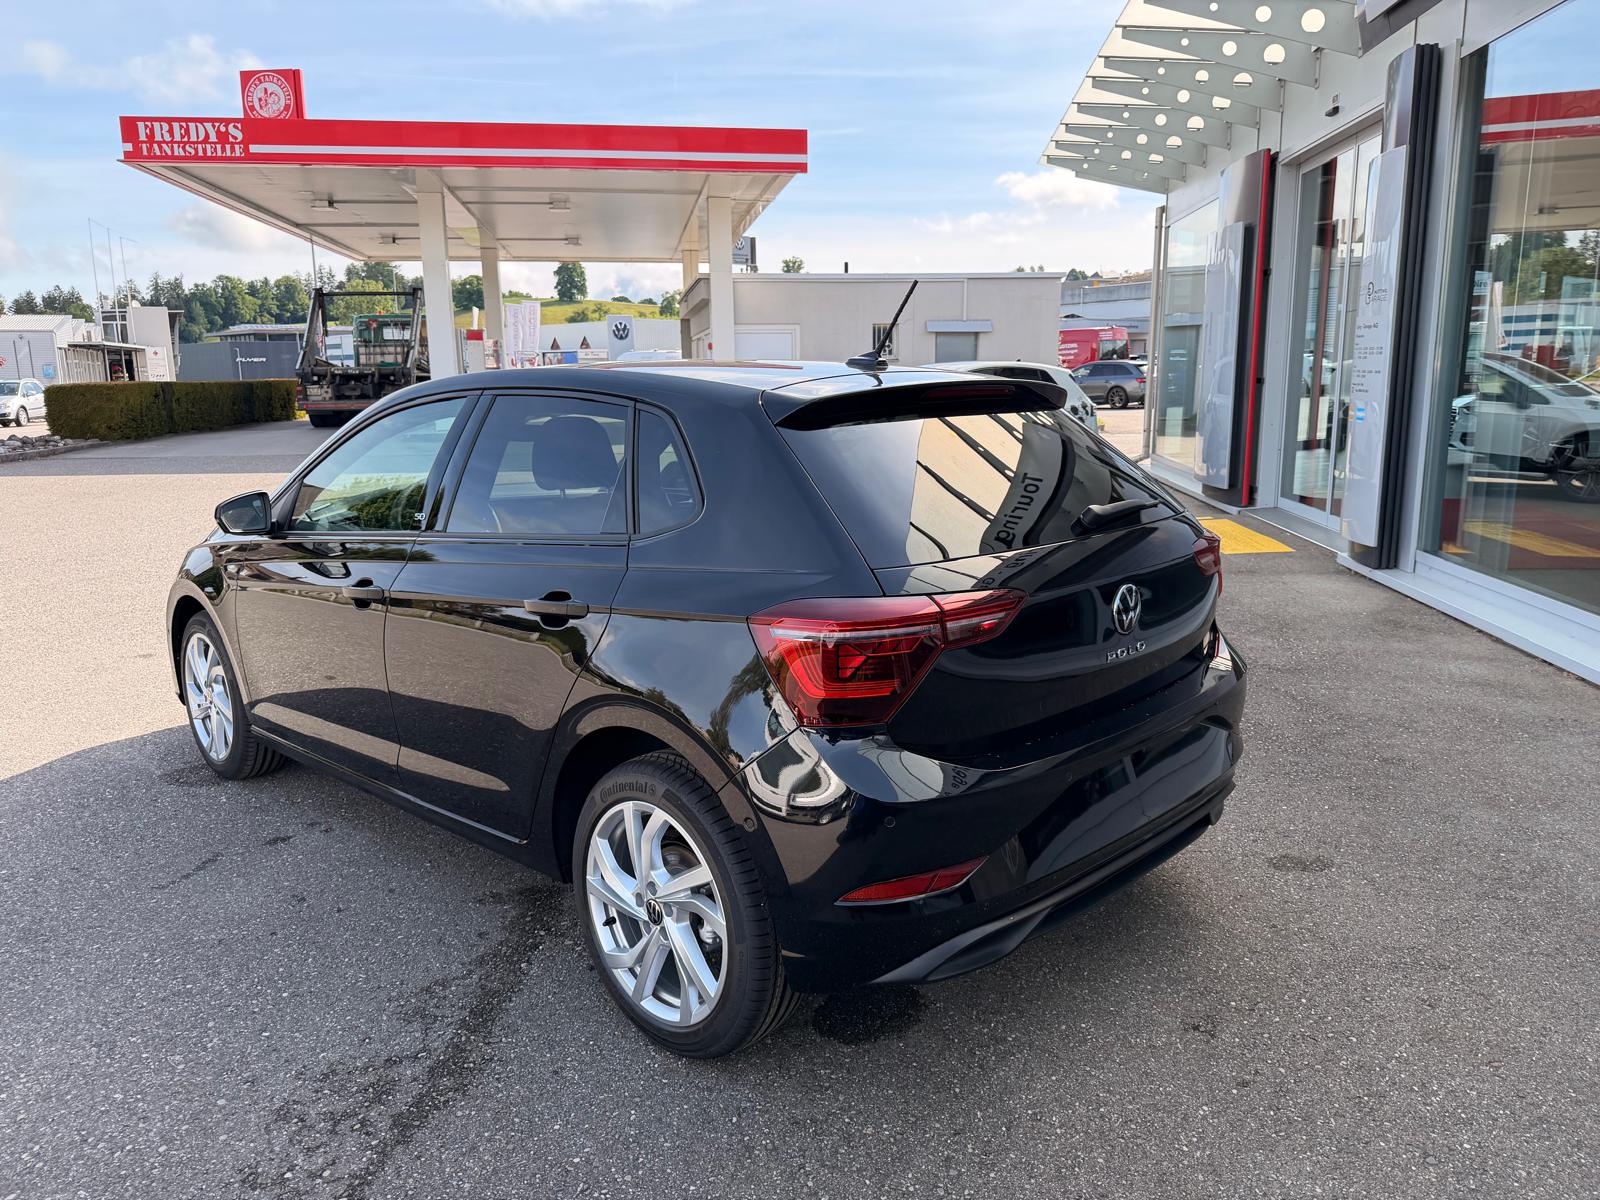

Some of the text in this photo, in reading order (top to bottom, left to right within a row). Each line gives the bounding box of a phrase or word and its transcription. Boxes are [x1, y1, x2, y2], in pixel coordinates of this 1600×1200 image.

[136, 121, 243, 142] FREDY'S
[139, 143, 245, 157] TANKSTELLE
[1106, 641, 1146, 663] POLO
[600, 780, 648, 803] Continental
